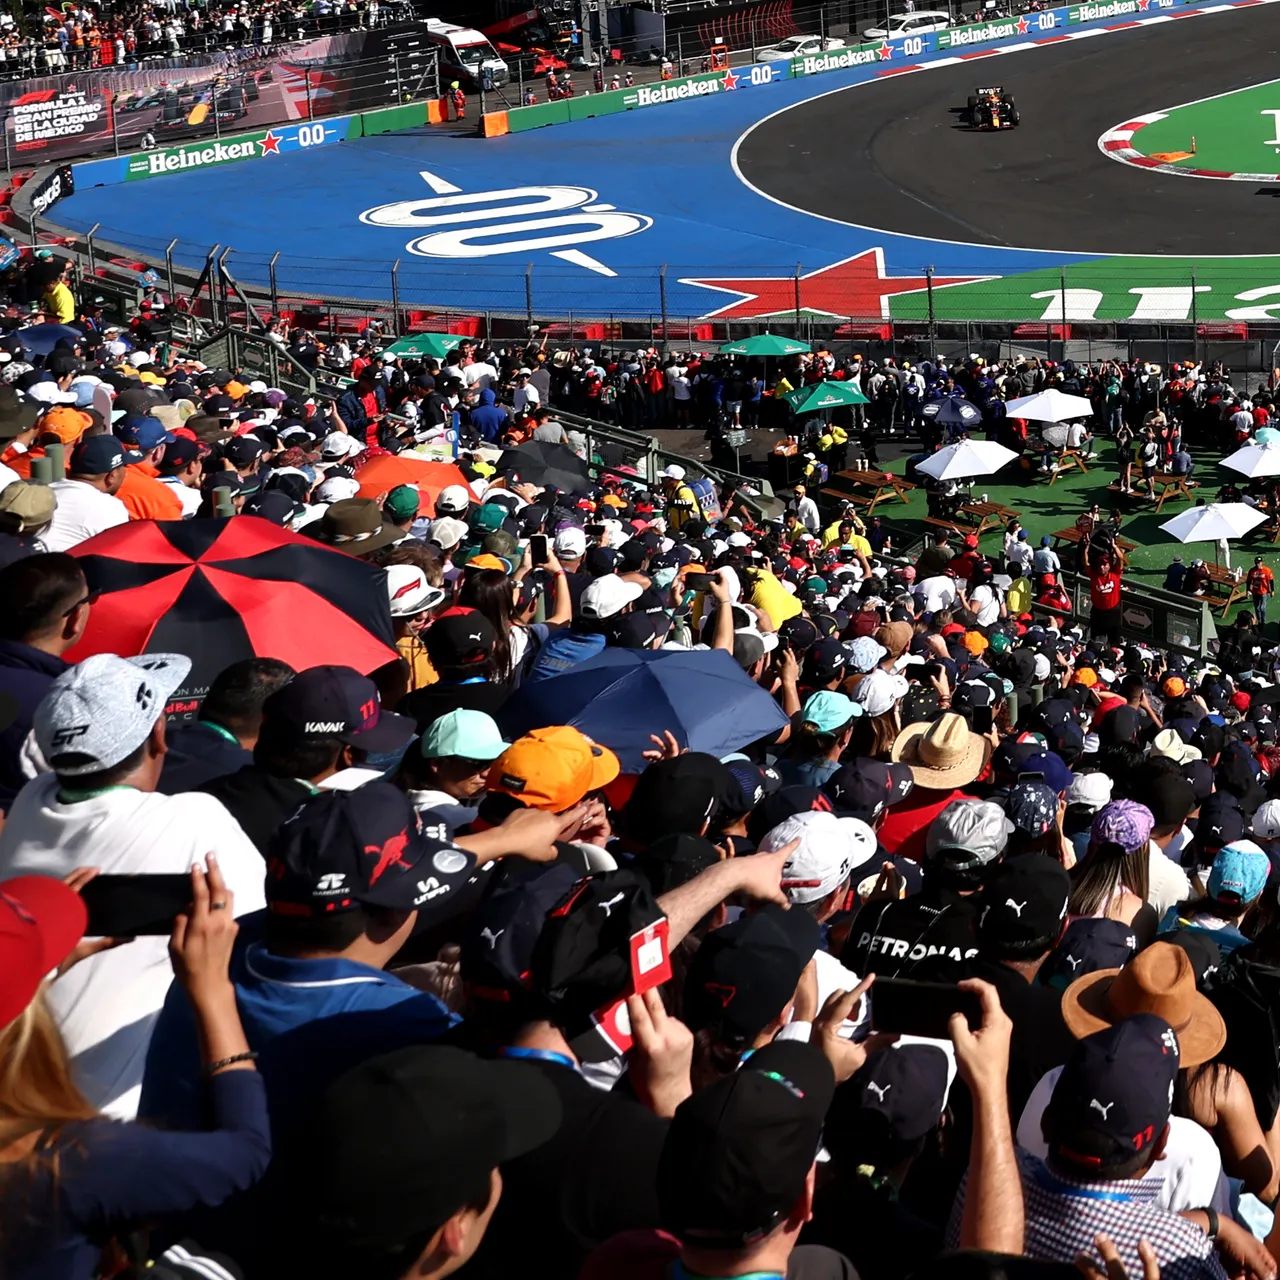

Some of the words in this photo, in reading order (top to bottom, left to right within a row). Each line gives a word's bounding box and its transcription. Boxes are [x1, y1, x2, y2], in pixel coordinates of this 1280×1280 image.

[950, 23, 1014, 47] Heineken
[802, 46, 875, 74] Heineken
[637, 78, 719, 106] Heineken
[13, 98, 75, 115] FORMULA
[14, 111, 52, 124] GRAN
[53, 104, 102, 120] PREMIO
[15, 122, 32, 132] DE
[34, 119, 51, 130] LA
[52, 112, 98, 126] CIUDAD
[16, 132, 33, 142] DE
[149, 141, 256, 174] Heineken
[304, 722, 345, 732] KAVAK
